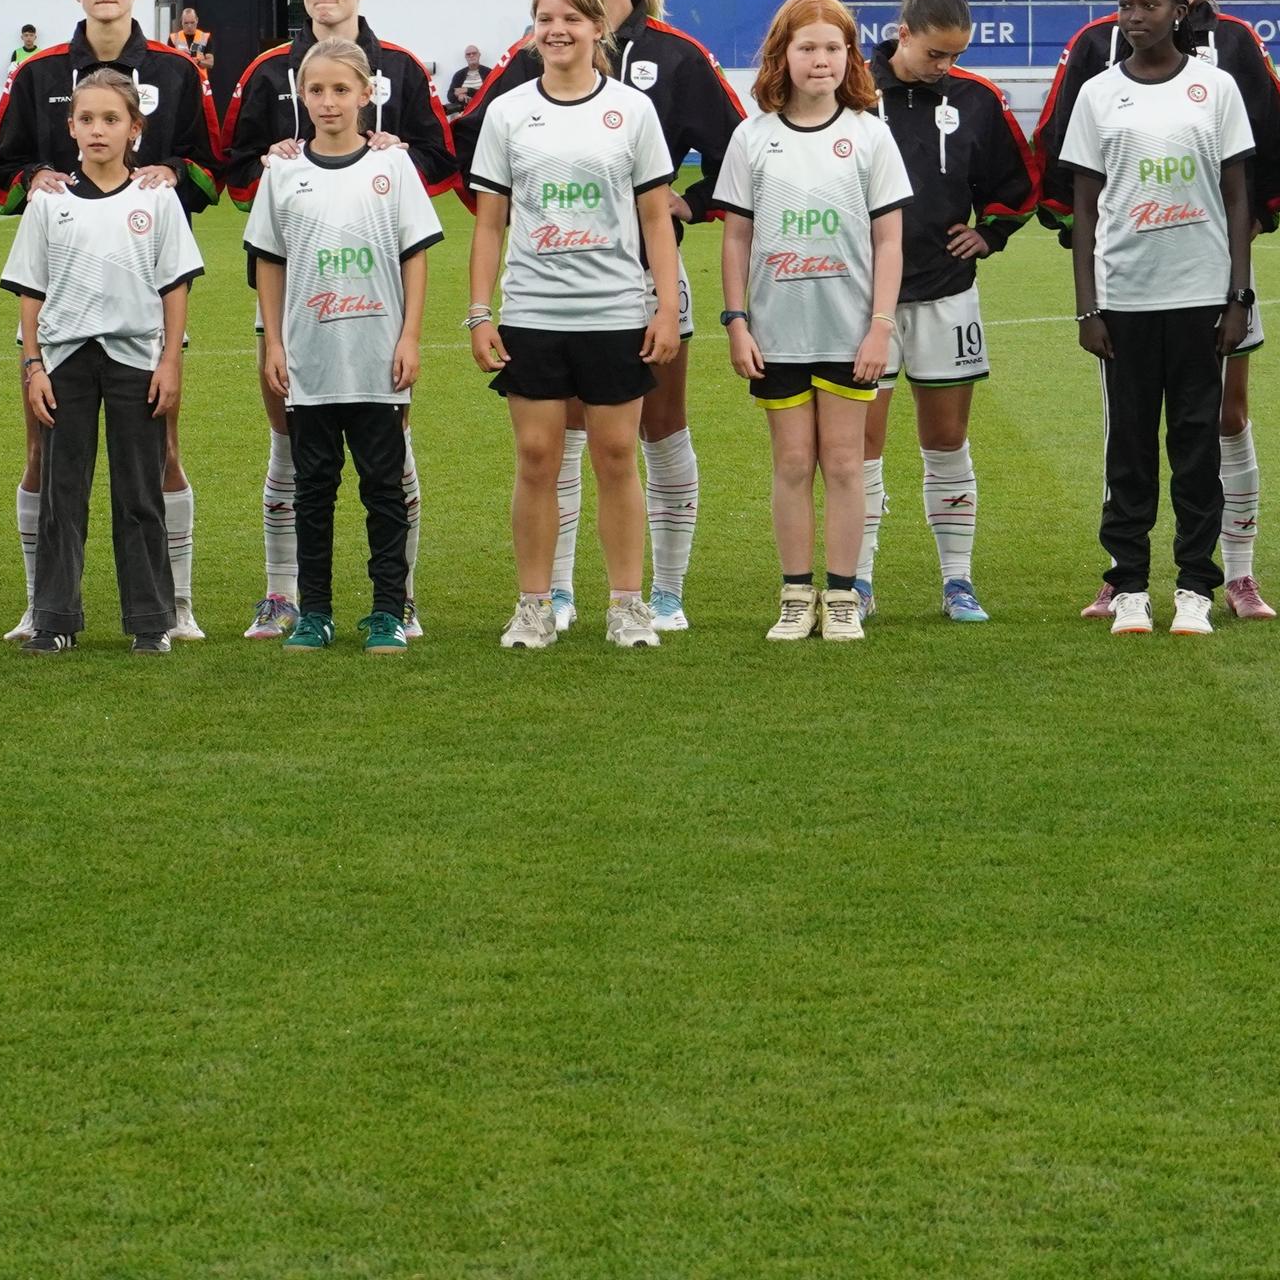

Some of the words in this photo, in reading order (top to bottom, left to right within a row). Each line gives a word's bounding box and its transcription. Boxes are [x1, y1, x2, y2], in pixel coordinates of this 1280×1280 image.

[1129, 201, 1207, 230] Ritchie
[529, 223, 609, 252] Ritchie
[765, 251, 849, 278] Ritchie
[306, 291, 385, 320] Ritchie
[952, 321, 982, 358] 19
[955, 357, 983, 366] STANNO
